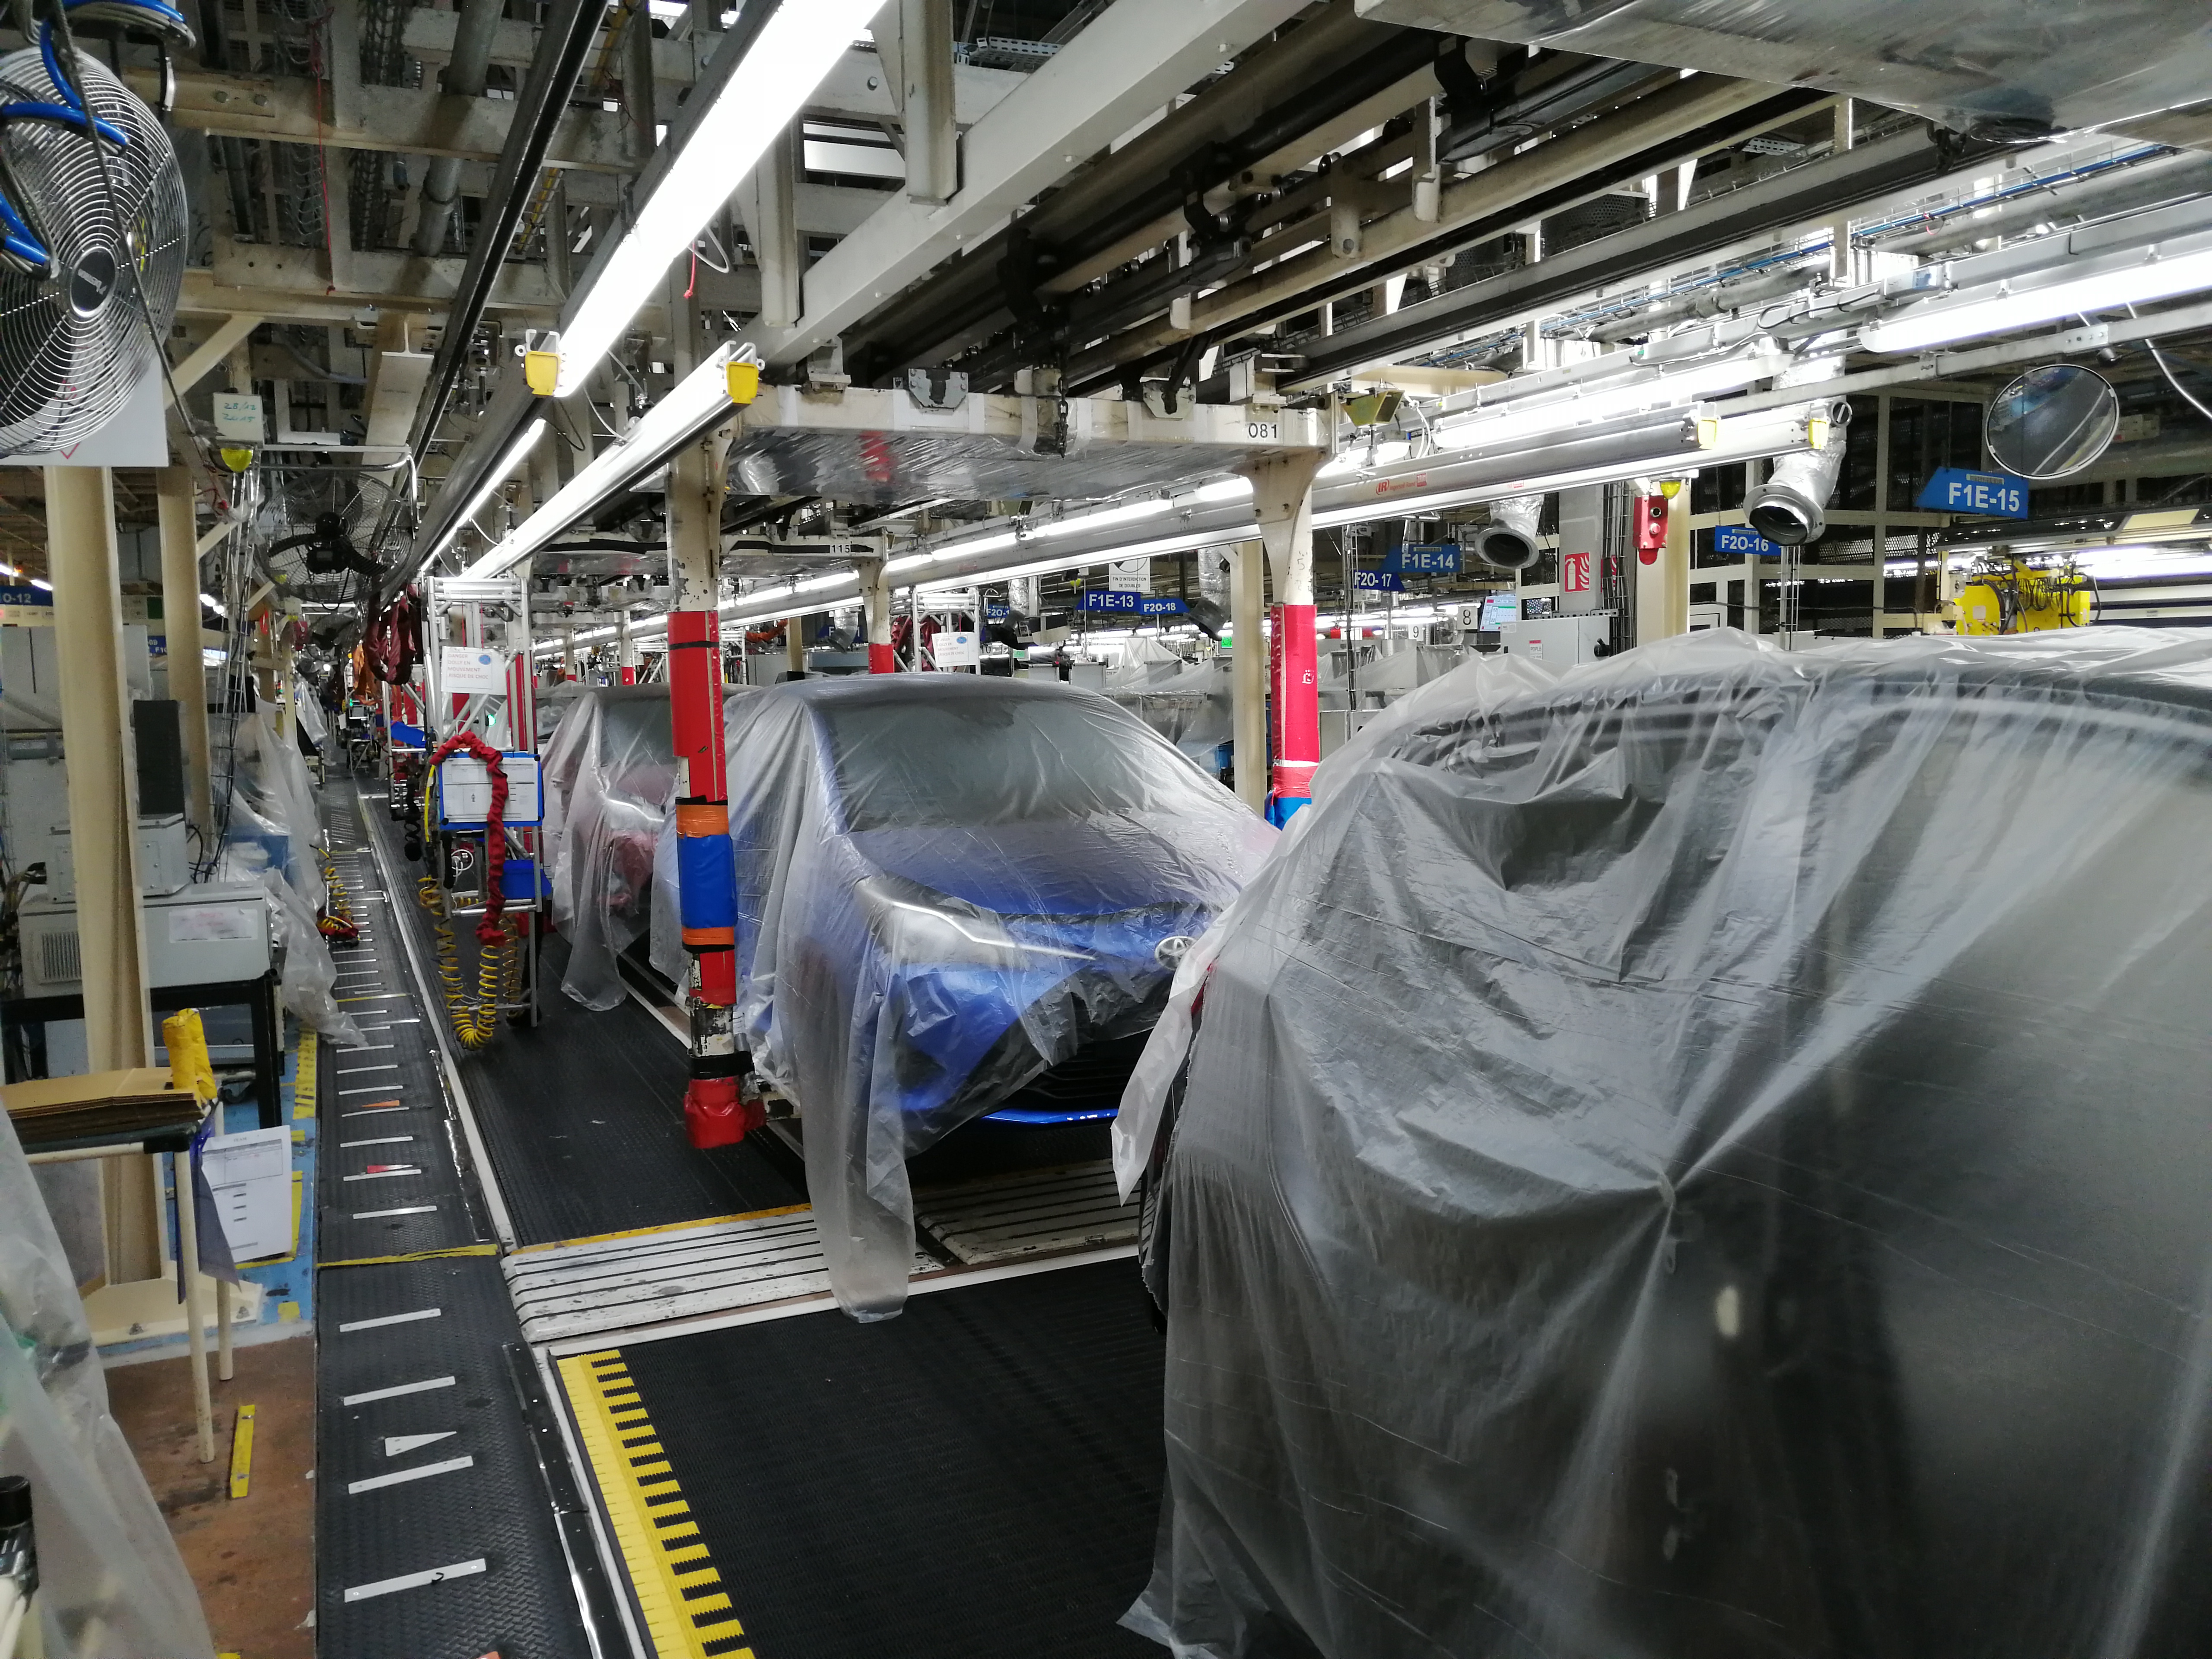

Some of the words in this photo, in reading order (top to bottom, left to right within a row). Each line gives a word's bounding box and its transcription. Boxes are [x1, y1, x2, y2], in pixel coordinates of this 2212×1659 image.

[1249, 423, 1276, 438] 081
[1949, 482, 2020, 512] F1E-15
[1402, 554, 1454, 569] F1E-14
[1089, 594, 1134, 607] F1E-13
[1463, 609, 1471, 625] 8
[1413, 626, 1419, 638] 9
